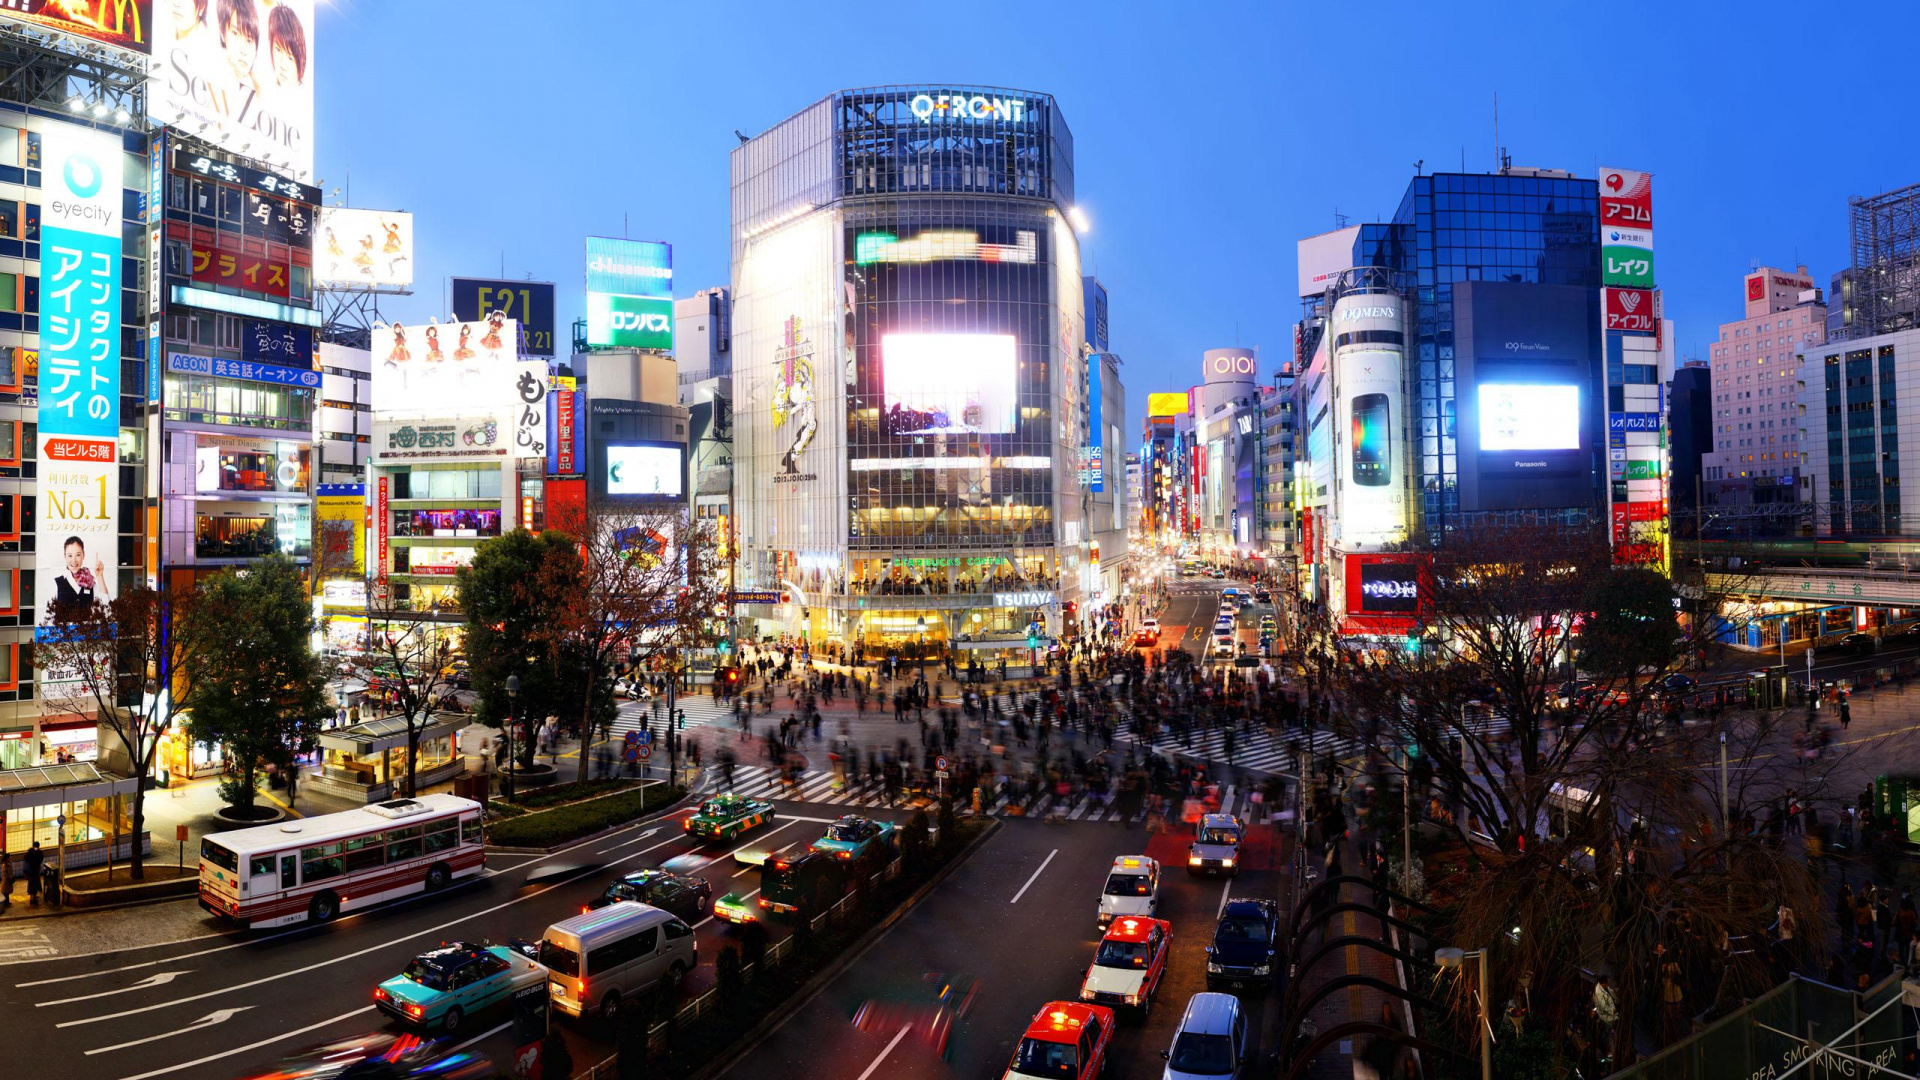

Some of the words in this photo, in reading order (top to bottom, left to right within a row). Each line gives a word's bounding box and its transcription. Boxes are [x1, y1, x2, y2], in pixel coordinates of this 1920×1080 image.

[238, 82, 300, 152] Zone
[911, 95, 1024, 123] QFRONT
[52, 200, 112, 227] eyecity
[1605, 202, 1650, 222] アコム
[1621, 233, 1645, 243] 新生銀行
[1608, 257, 1649, 276] レイク
[1774, 276, 1797, 288] TOKYU
[1799, 281, 1813, 289] INN
[1609, 313, 1652, 329] アイフル
[49, 246, 83, 418] アイシティ
[87, 252, 111, 420] コンタクトの
[1505, 342, 1520, 353] 109
[1535, 343, 1550, 351] Vision
[173, 354, 208, 372] AEON
[215, 360, 298, 382] 英会話イーオン
[303, 374, 315, 384] 6F
[516, 371, 545, 454] もんじゃ
[418, 432, 455, 448] 西村
[559, 394, 571, 469] 三千里薬品
[53, 442, 110, 459] 当ビル5階
[209, 438, 235, 446] Natural
[237, 440, 260, 448] Dining
[1628, 464, 1647, 474] レイク
[46, 474, 111, 519] No.1
[46, 523, 110, 532] コンタクトショップ
[894, 558, 961, 567] STARBUCKS
[966, 557, 1007, 566] COFFEE
[1801, 581, 1811, 592] JR
[1826, 581, 1862, 596] 渋谷
[531, 983, 544, 993] BUS
[1783, 1045, 1855, 1077] SMOKING
[1867, 1045, 1897, 1080] AREA
